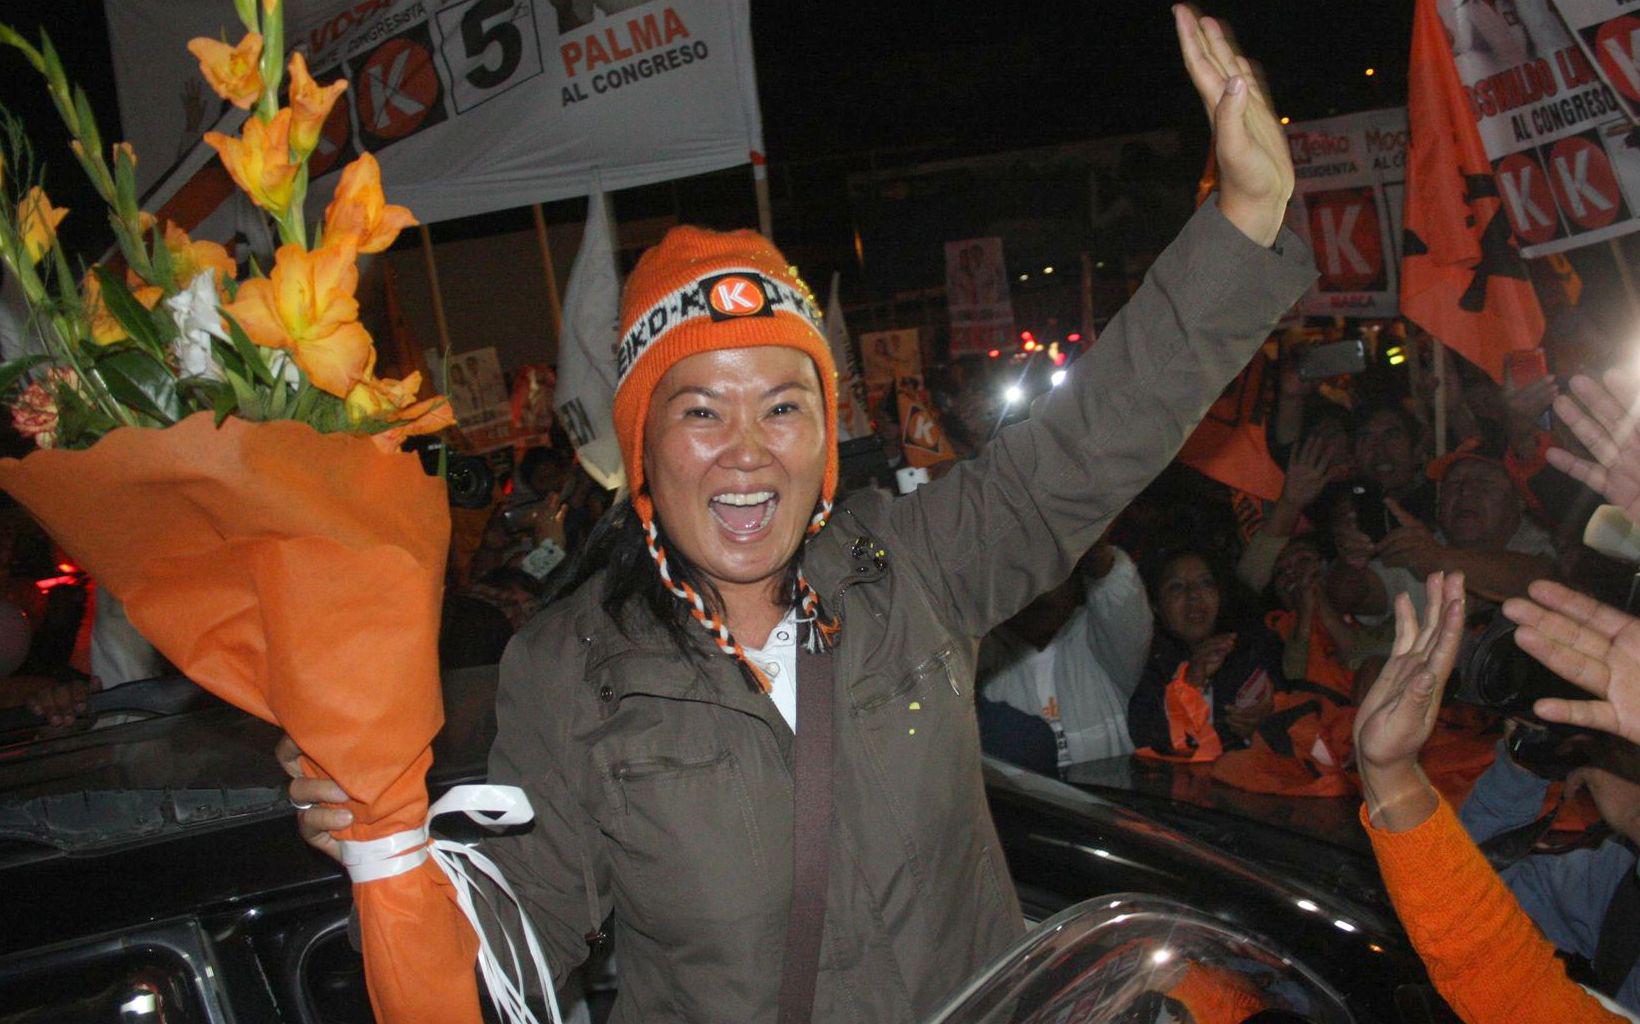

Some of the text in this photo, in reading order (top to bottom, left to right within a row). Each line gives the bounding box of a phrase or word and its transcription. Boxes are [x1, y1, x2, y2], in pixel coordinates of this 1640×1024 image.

[460, 0, 523, 89] 5
[559, 6, 691, 78] PALMA
[561, 40, 710, 107] AL CONGRESO
[1510, 84, 1618, 142] AL CONGRESO
[1500, 149, 1614, 232] K K
[1320, 203, 1373, 276] K
[717, 282, 756, 312] K
